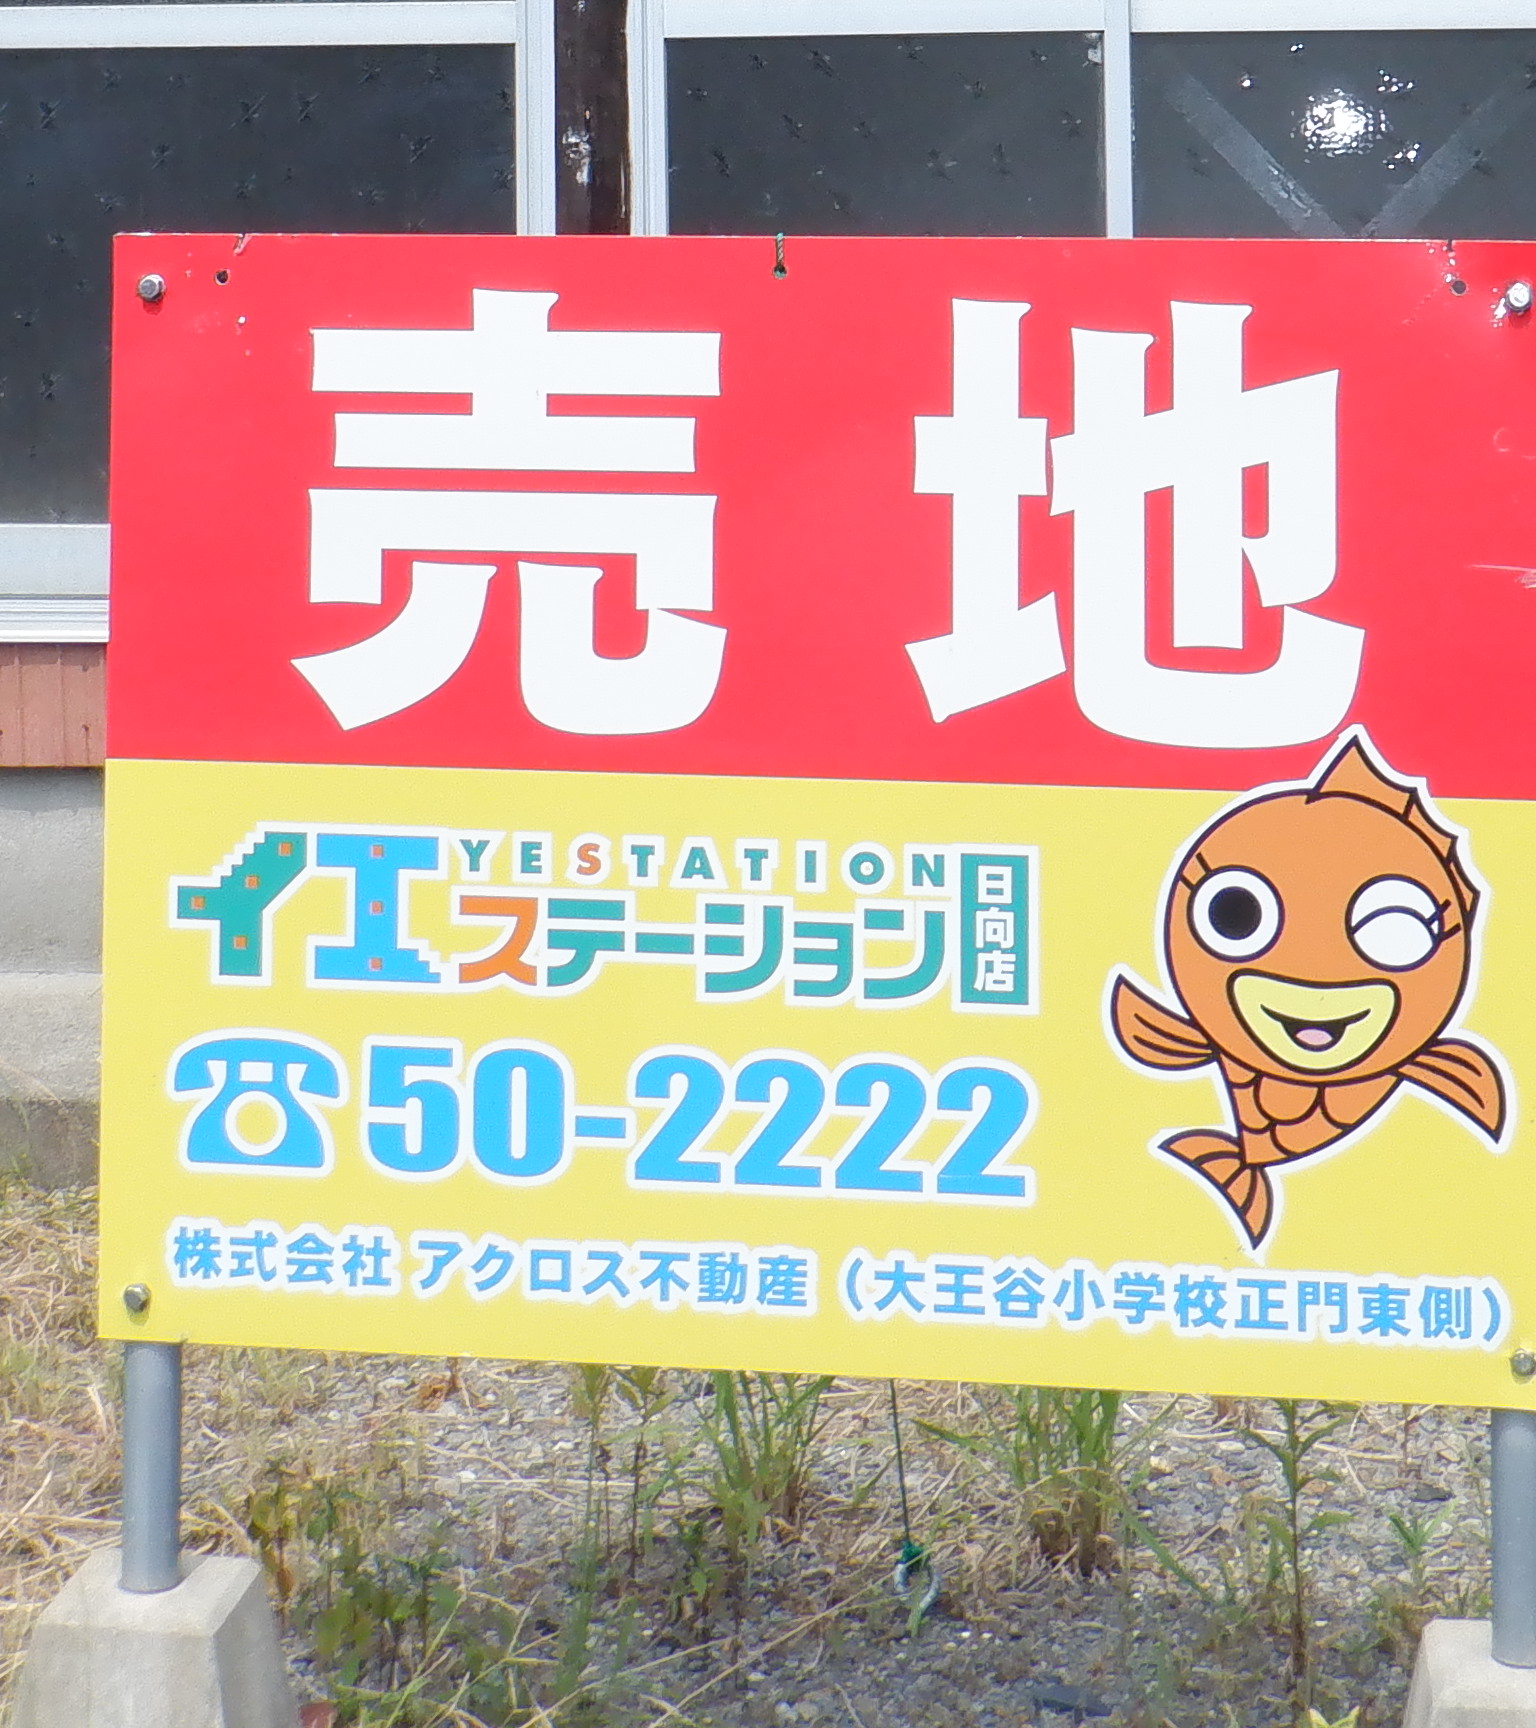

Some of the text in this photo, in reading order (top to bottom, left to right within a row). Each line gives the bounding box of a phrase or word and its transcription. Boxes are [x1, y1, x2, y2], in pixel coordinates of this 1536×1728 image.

[289, 286, 1367, 751] 売地
[458, 836, 947, 887] YESTATION
[973, 864, 1016, 993] 日向店
[367, 1043, 1030, 1199] 50-2222
[173, 1226, 1502, 1342] 株式会社 アクロス不動産 （大王谷小学校正門東側）
